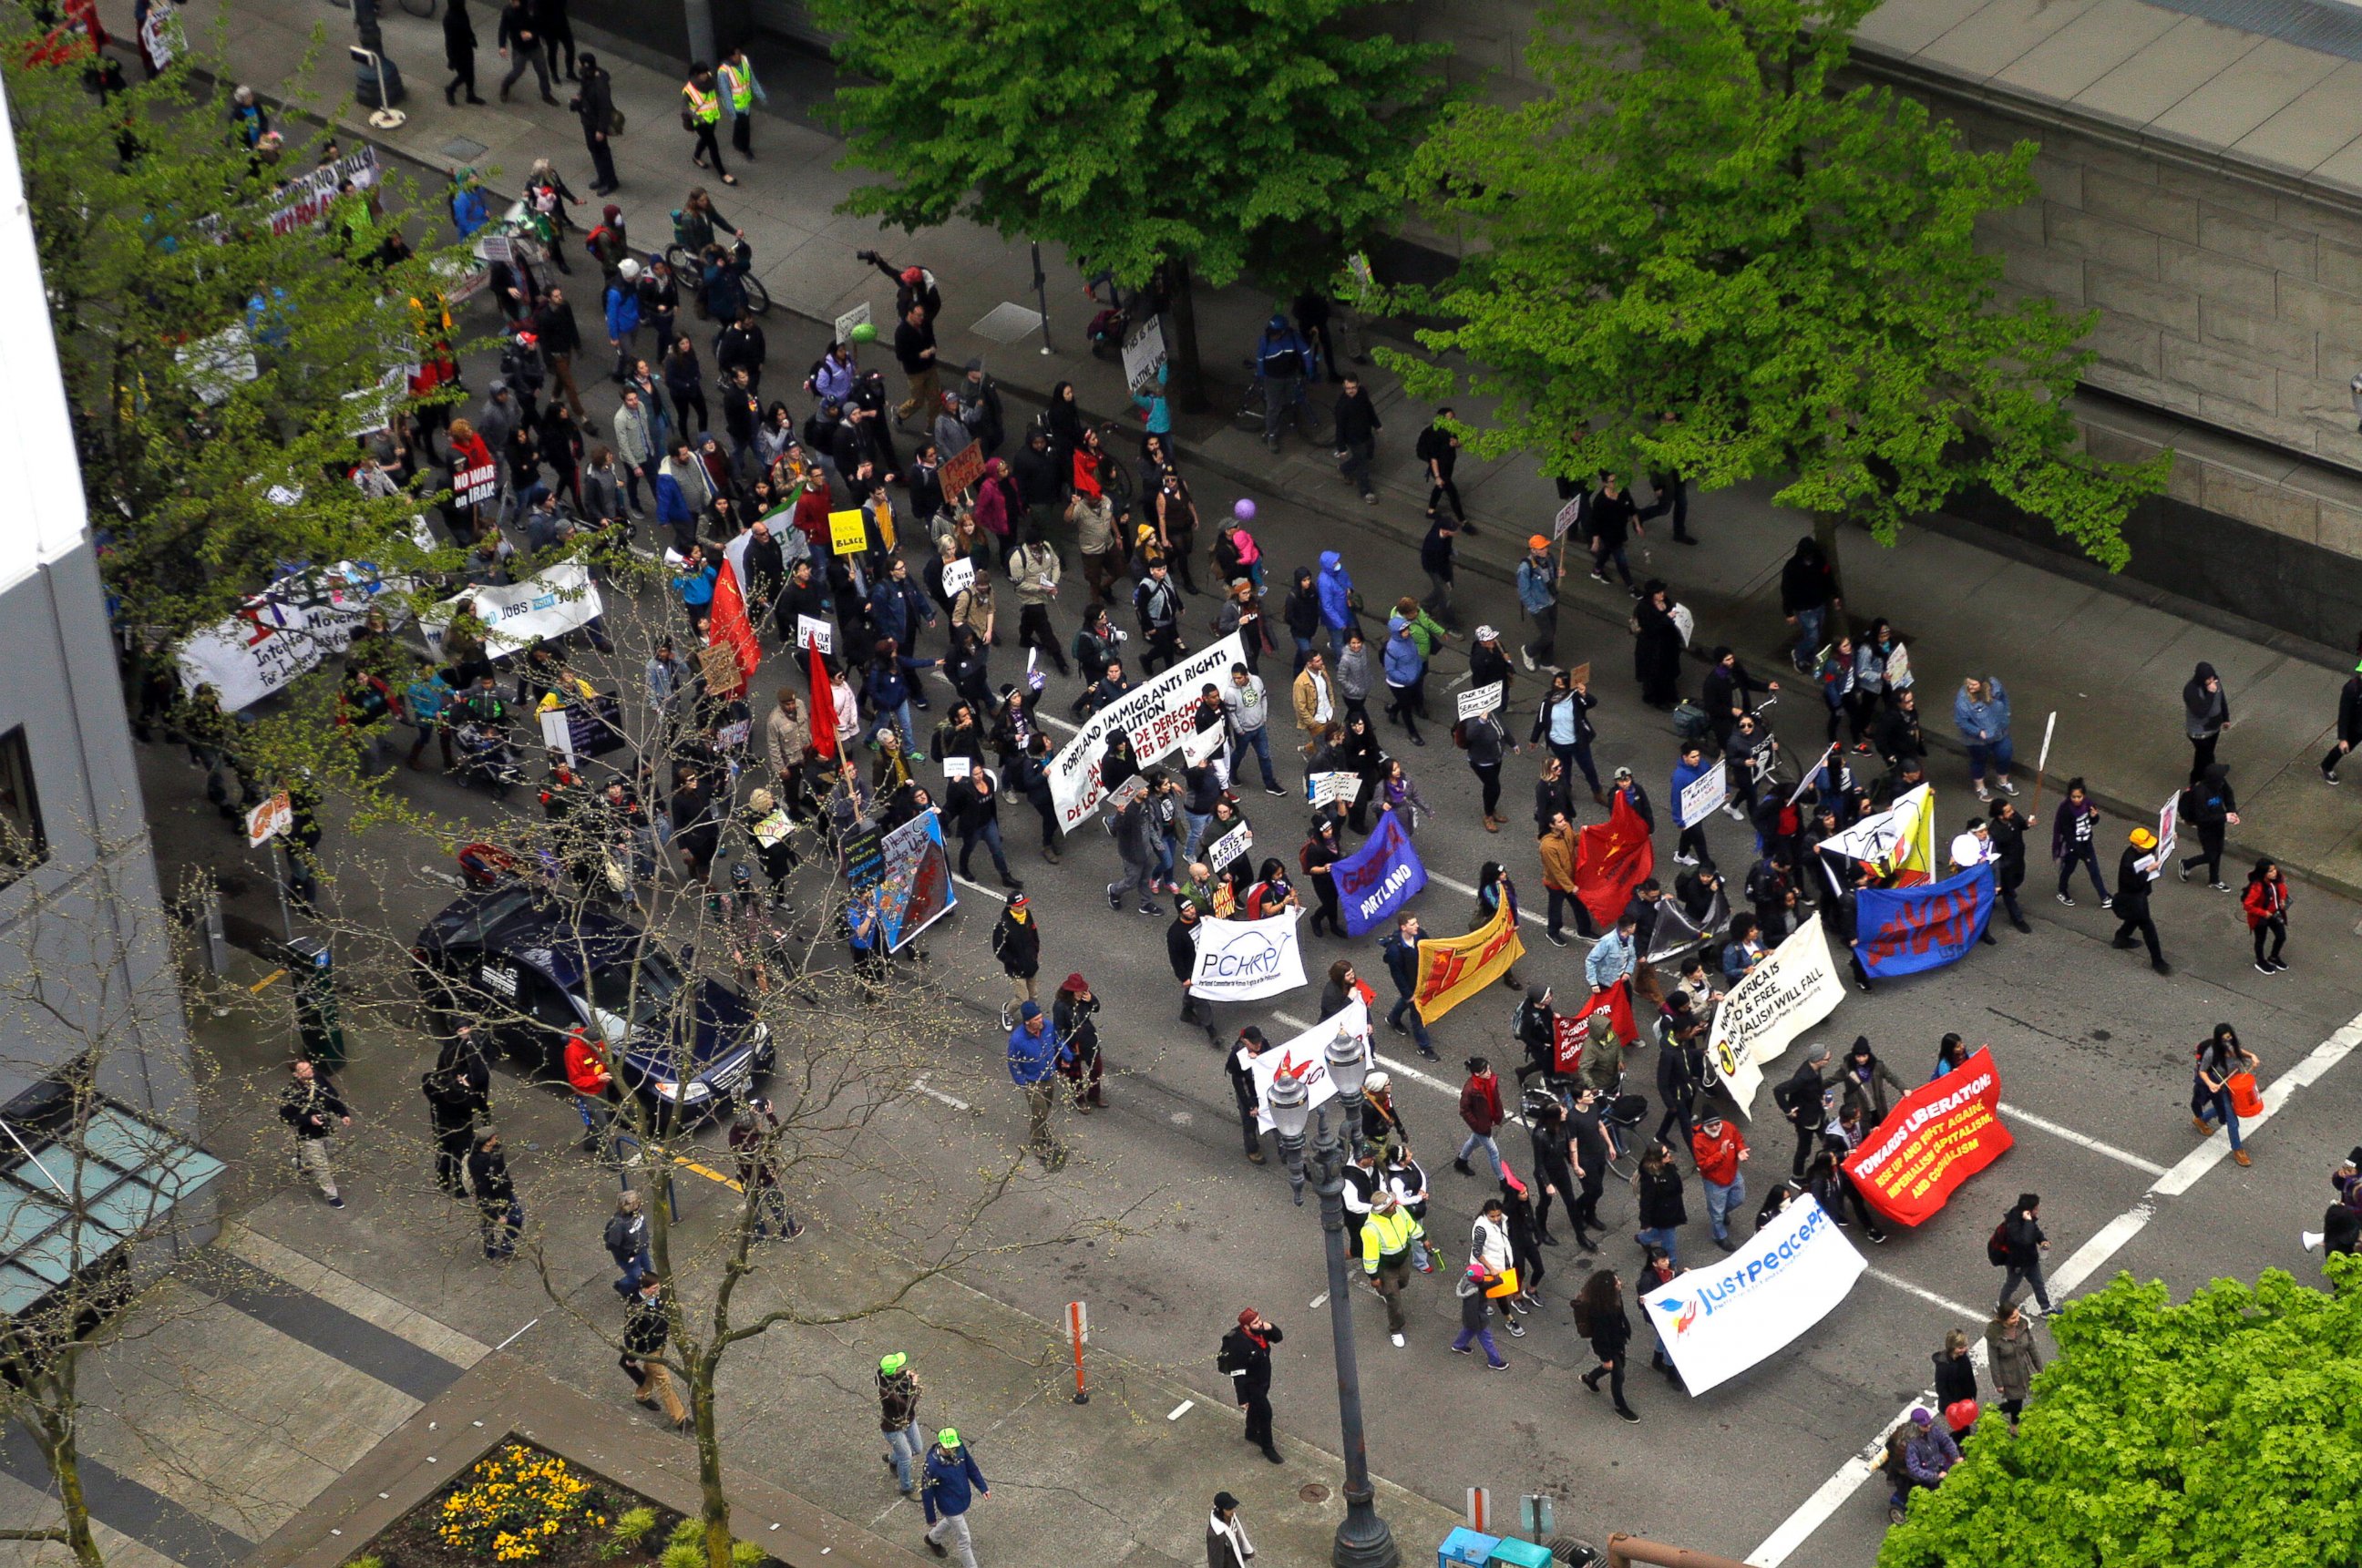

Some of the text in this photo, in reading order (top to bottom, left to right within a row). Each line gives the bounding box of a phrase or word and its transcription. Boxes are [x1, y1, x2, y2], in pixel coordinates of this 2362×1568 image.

[1130, 364, 1152, 392] NATIVE
[454, 464, 495, 491] NO WAR
[455, 480, 495, 508] on IRAN
[836, 537, 864, 548] BLACK
[957, 570, 973, 580] RISE
[500, 600, 529, 620] JOBS
[1062, 724, 1102, 776] PORTLAND
[1103, 673, 1183, 731] IMMIGRANTS
[1184, 649, 1228, 683] RIGHTS
[1135, 730, 1151, 745] DE
[1066, 803, 1083, 823] DE
[1157, 733, 1172, 750] DE
[1211, 830, 1247, 864] RESIST
[1217, 844, 1244, 868] UNITE
[1219, 831, 1236, 847] RISE
[1359, 863, 1413, 921] PORTLAND
[1866, 881, 1978, 968] BAYAN
[1736, 968, 1772, 1005] AFRICA
[1770, 960, 1782, 976] IS
[1744, 1002, 1754, 1015] &
[1753, 981, 1782, 1009] FREE,
[1773, 986, 1802, 1010] WILL
[1801, 967, 1824, 992] FALL
[1854, 1125, 1910, 1180] TOWARDS
[1874, 1167, 1895, 1188] RISE
[1891, 1156, 1904, 1173] UP
[1902, 1142, 1923, 1163] AND
[1886, 1148, 1936, 1199] IMPERIALISM
[1911, 1179, 1931, 1200] AND
